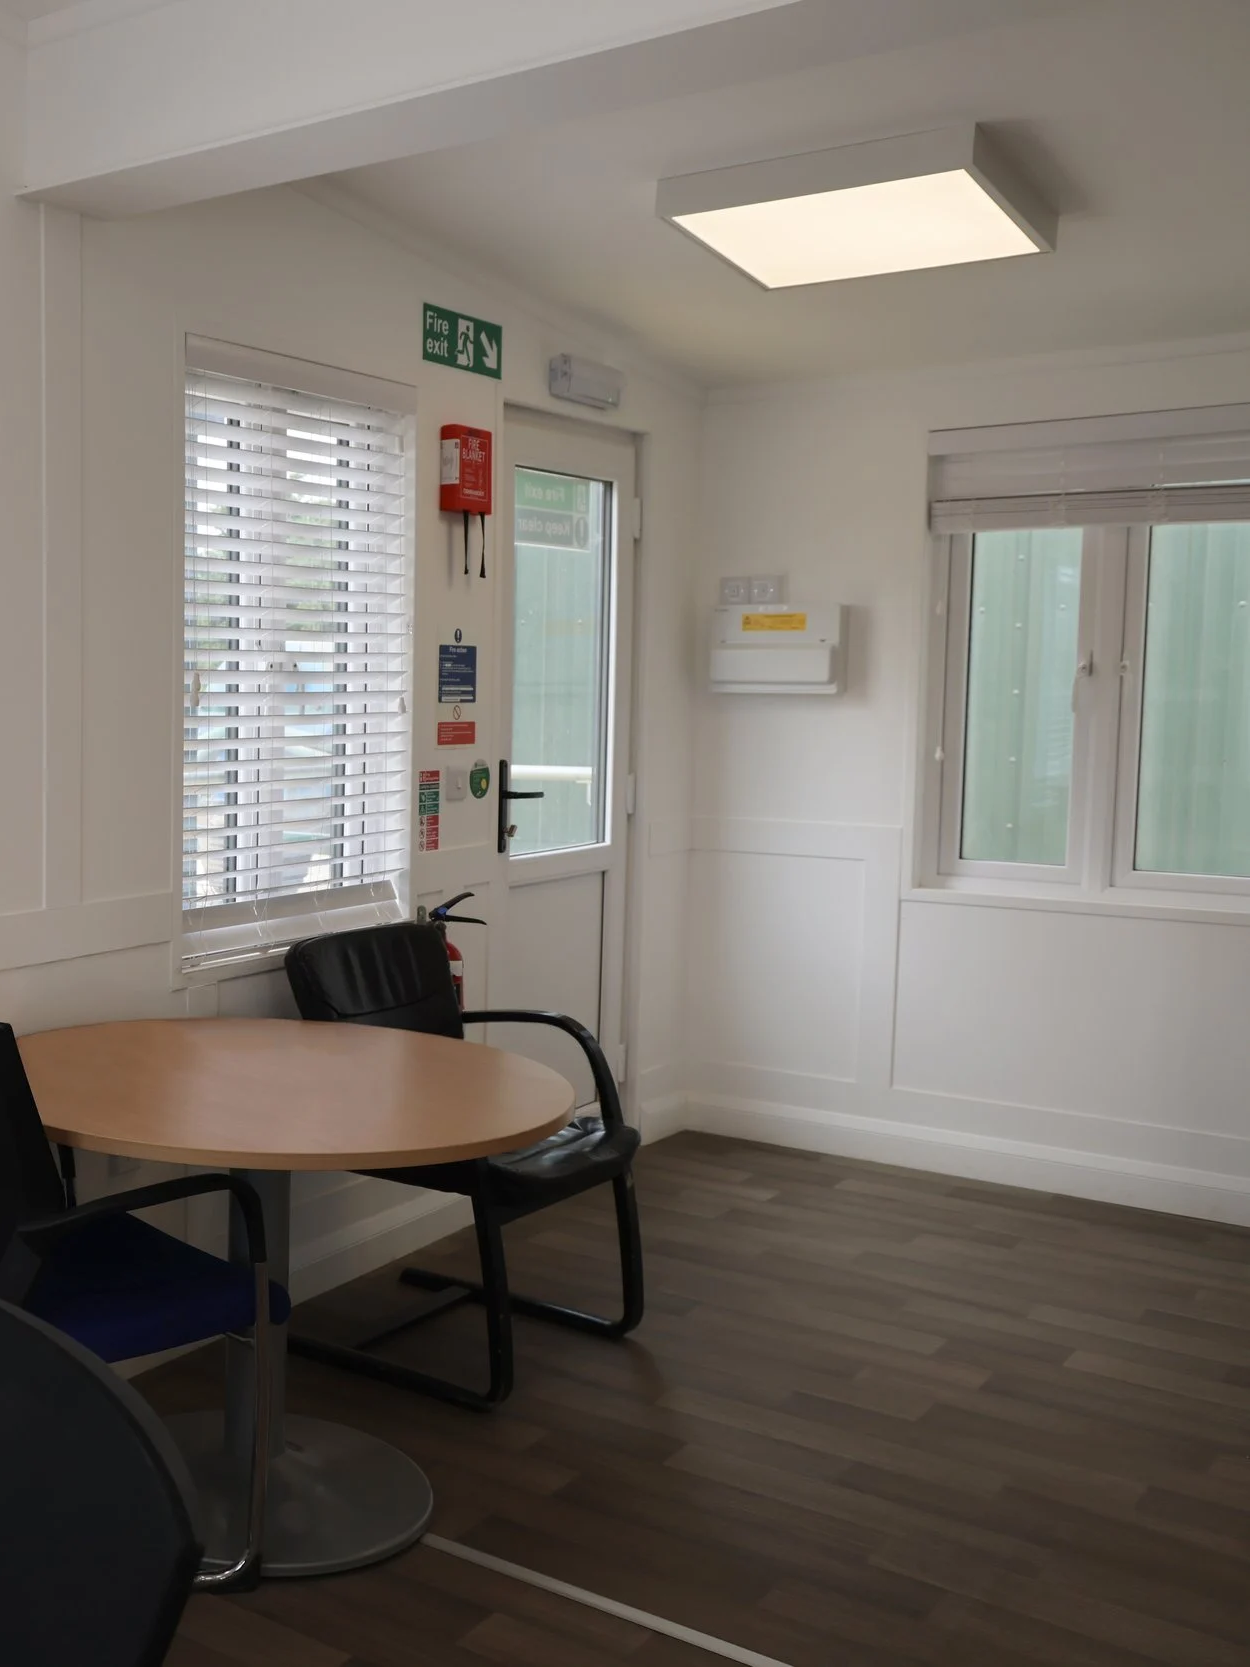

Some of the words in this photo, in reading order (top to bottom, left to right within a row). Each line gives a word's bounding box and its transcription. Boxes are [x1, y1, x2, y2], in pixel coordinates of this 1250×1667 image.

[426, 310, 449, 335] Fire
[426, 337, 449, 357] exit
[468, 438, 480, 451] FIRE
[462, 448, 486, 463] BLANKET
